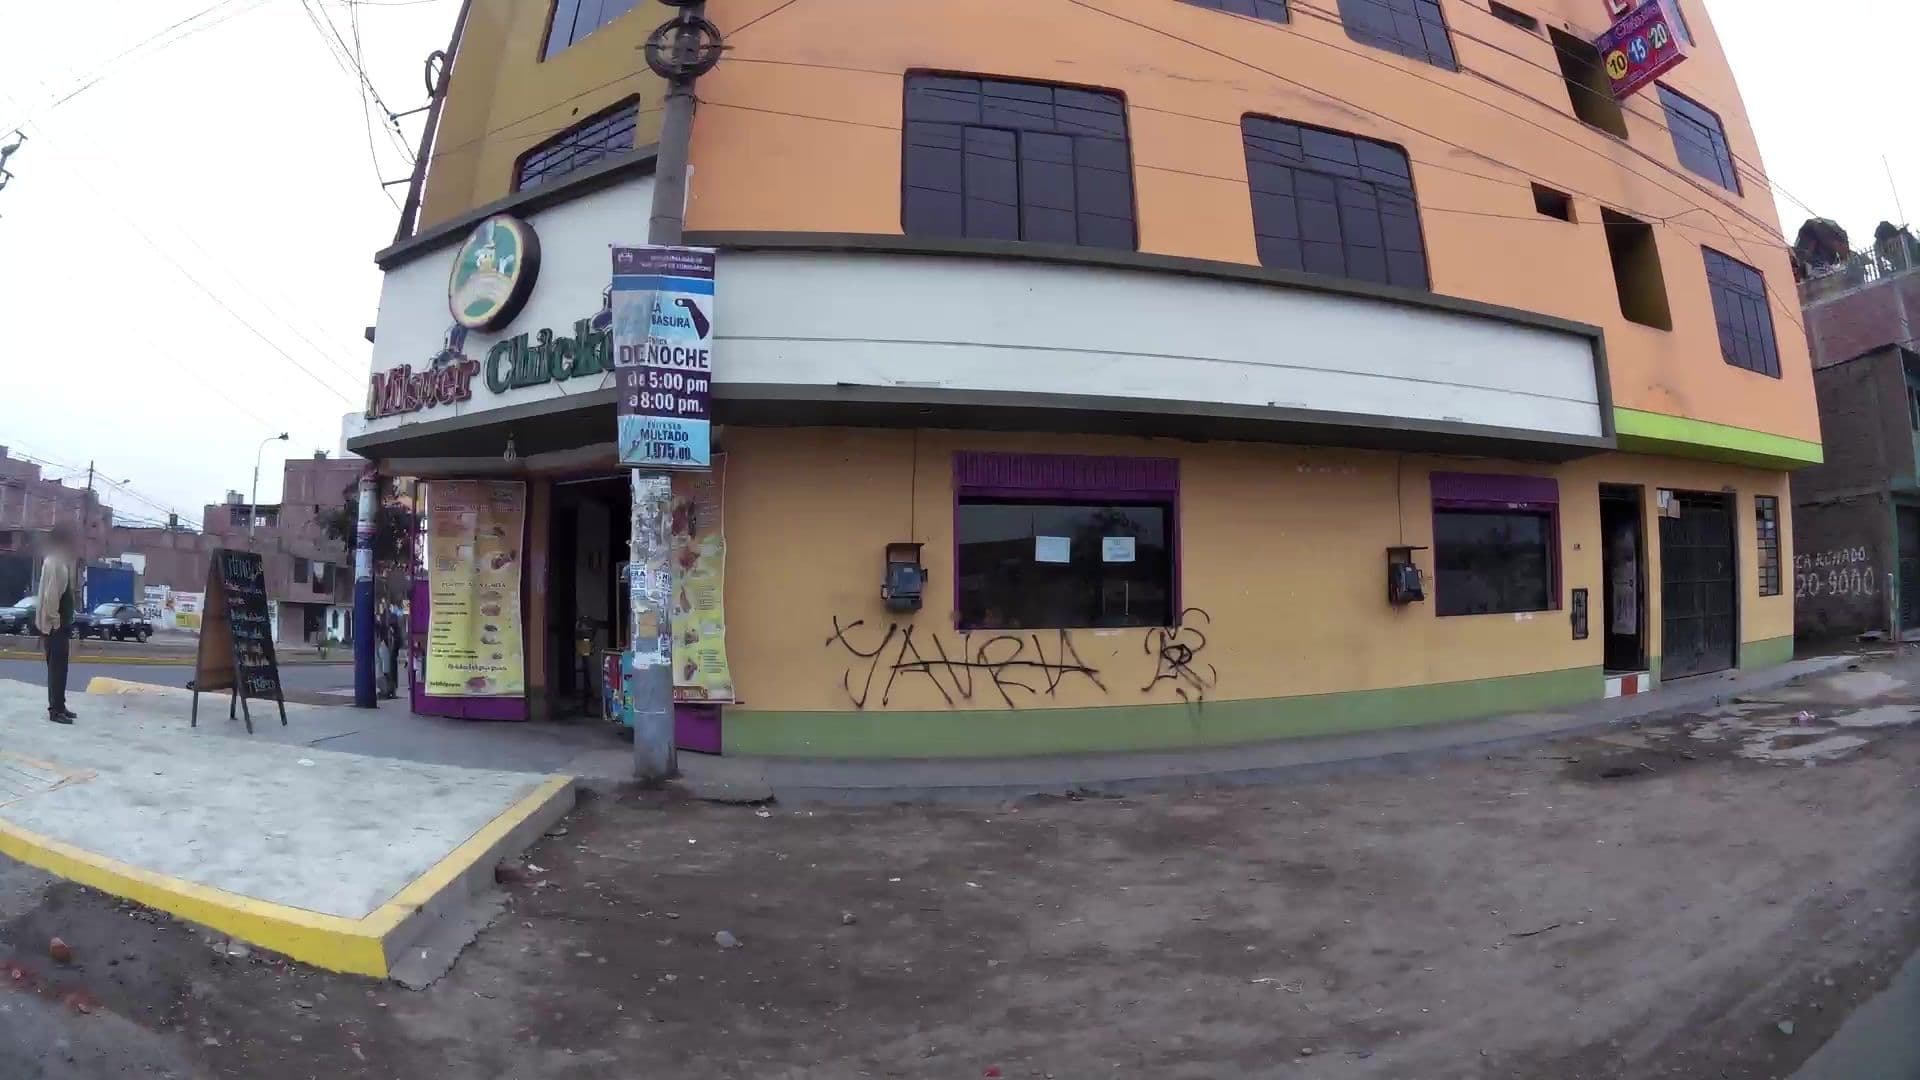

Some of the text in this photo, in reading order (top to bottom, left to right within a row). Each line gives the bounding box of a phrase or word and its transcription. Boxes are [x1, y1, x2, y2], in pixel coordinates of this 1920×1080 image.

[1610, 23, 1668, 75] 10 15 20
[651, 314, 691, 328] BASURA
[647, 345, 709, 368] NOCHE
[365, 359, 481, 420] Mister
[627, 371, 708, 394] de 5:00 pm
[628, 391, 704, 414] a 8:00 pm.
[640, 428, 689, 442] MULTADO
